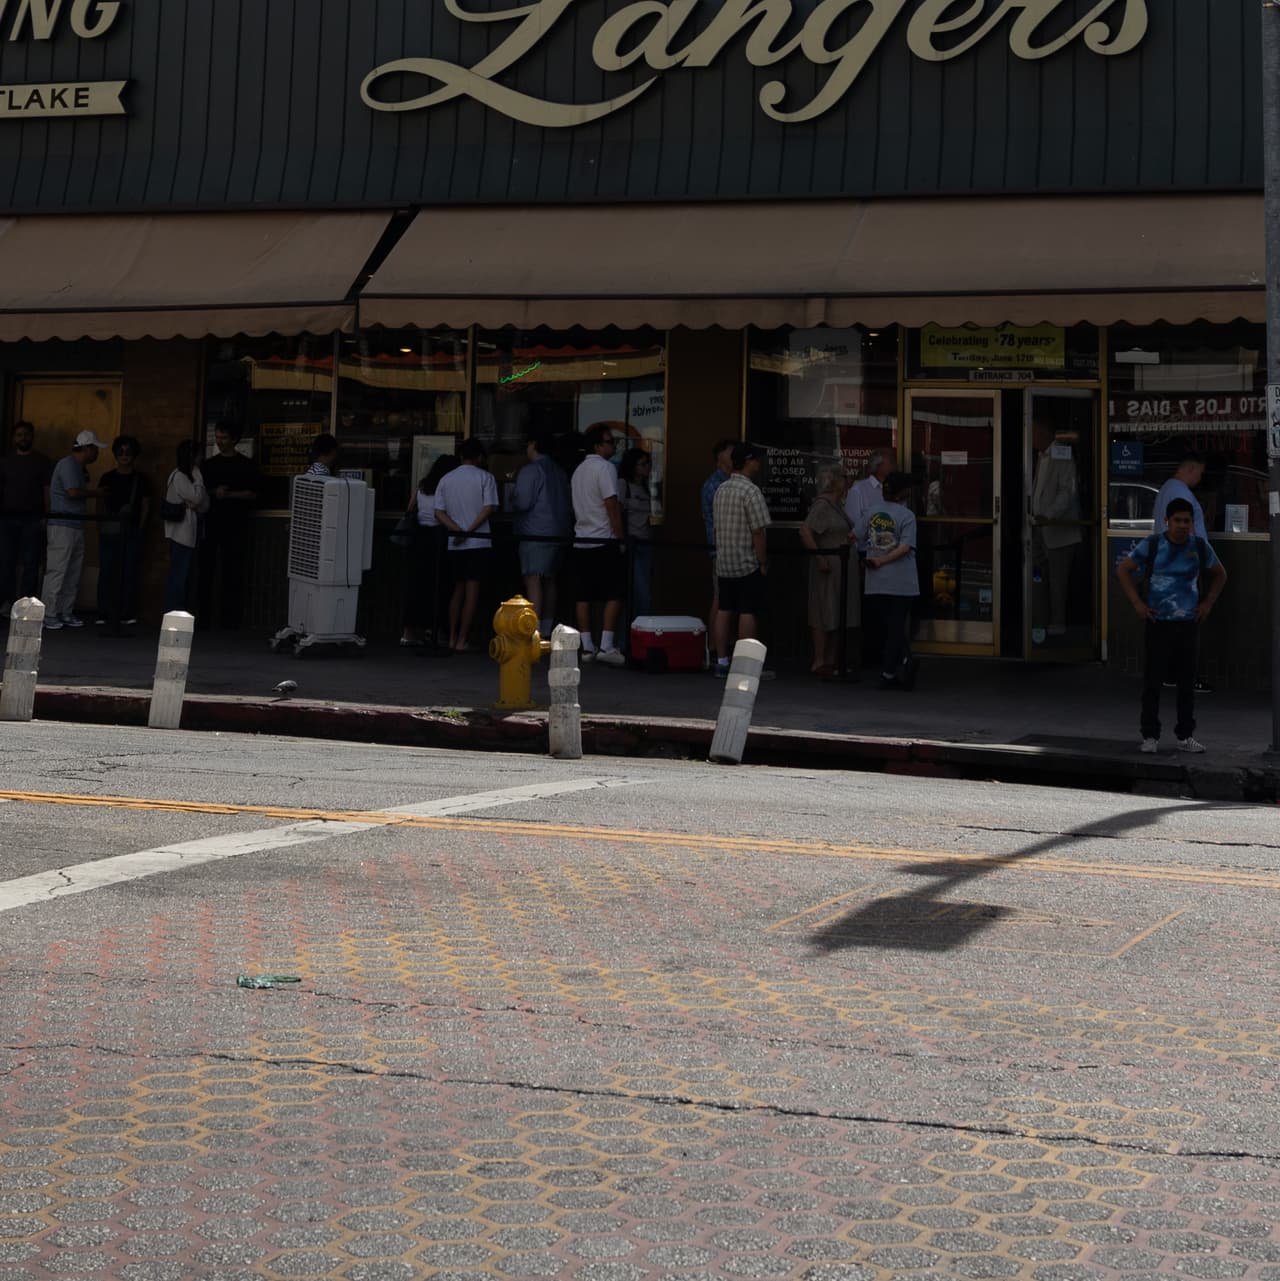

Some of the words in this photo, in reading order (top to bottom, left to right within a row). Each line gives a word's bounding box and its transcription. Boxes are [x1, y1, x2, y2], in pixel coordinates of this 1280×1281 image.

[928, 335, 989, 347] Celebrating
[974, 371, 1013, 380] ENTRANCE
[766, 448, 800, 457] MONDAY
[771, 467, 806, 476] CLOSED
